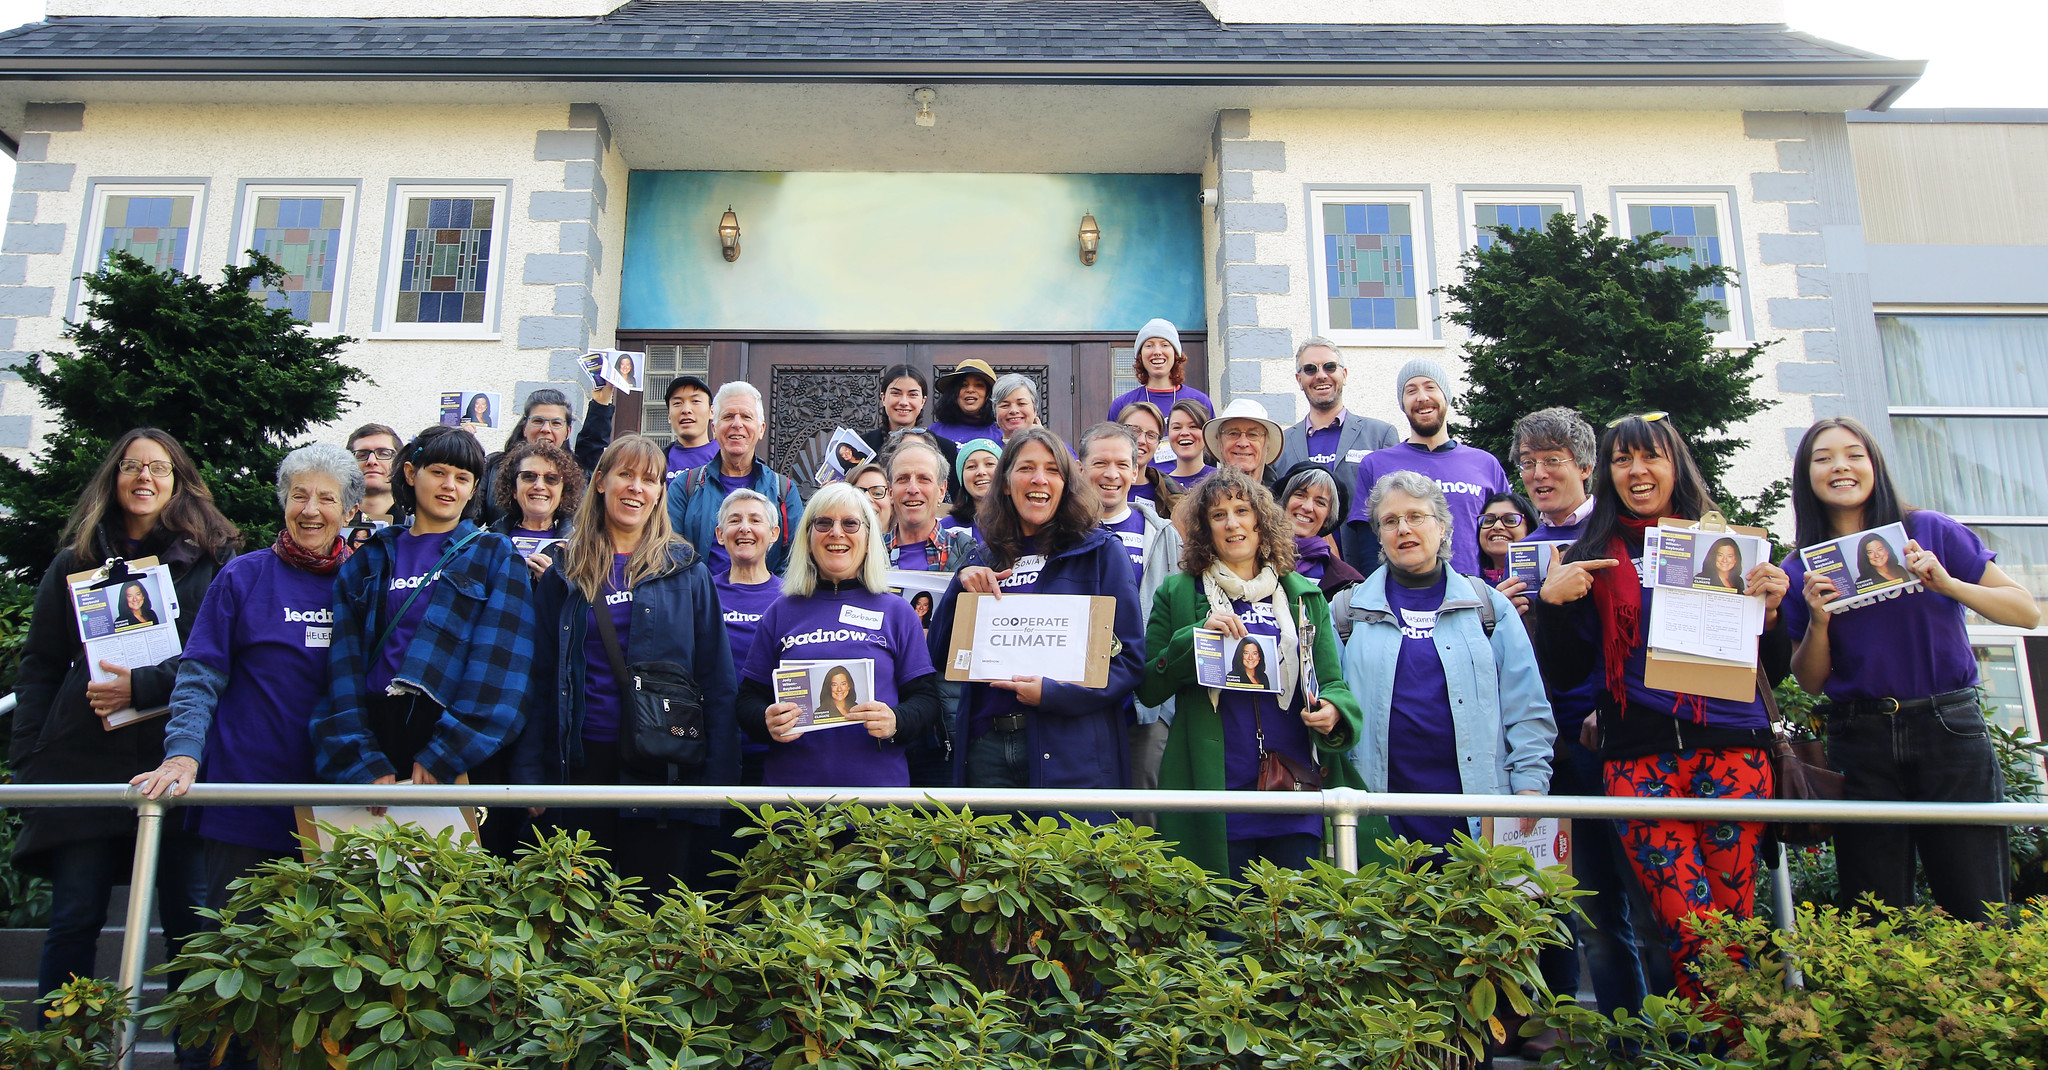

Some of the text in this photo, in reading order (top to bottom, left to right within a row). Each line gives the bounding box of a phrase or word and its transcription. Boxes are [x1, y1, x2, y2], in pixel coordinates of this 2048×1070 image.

[1014, 558, 1040, 570] SONIA
[844, 609, 879, 623] Barbara
[991, 617, 1069, 627] COOPERATE
[989, 634, 1068, 647] CLIMATE
